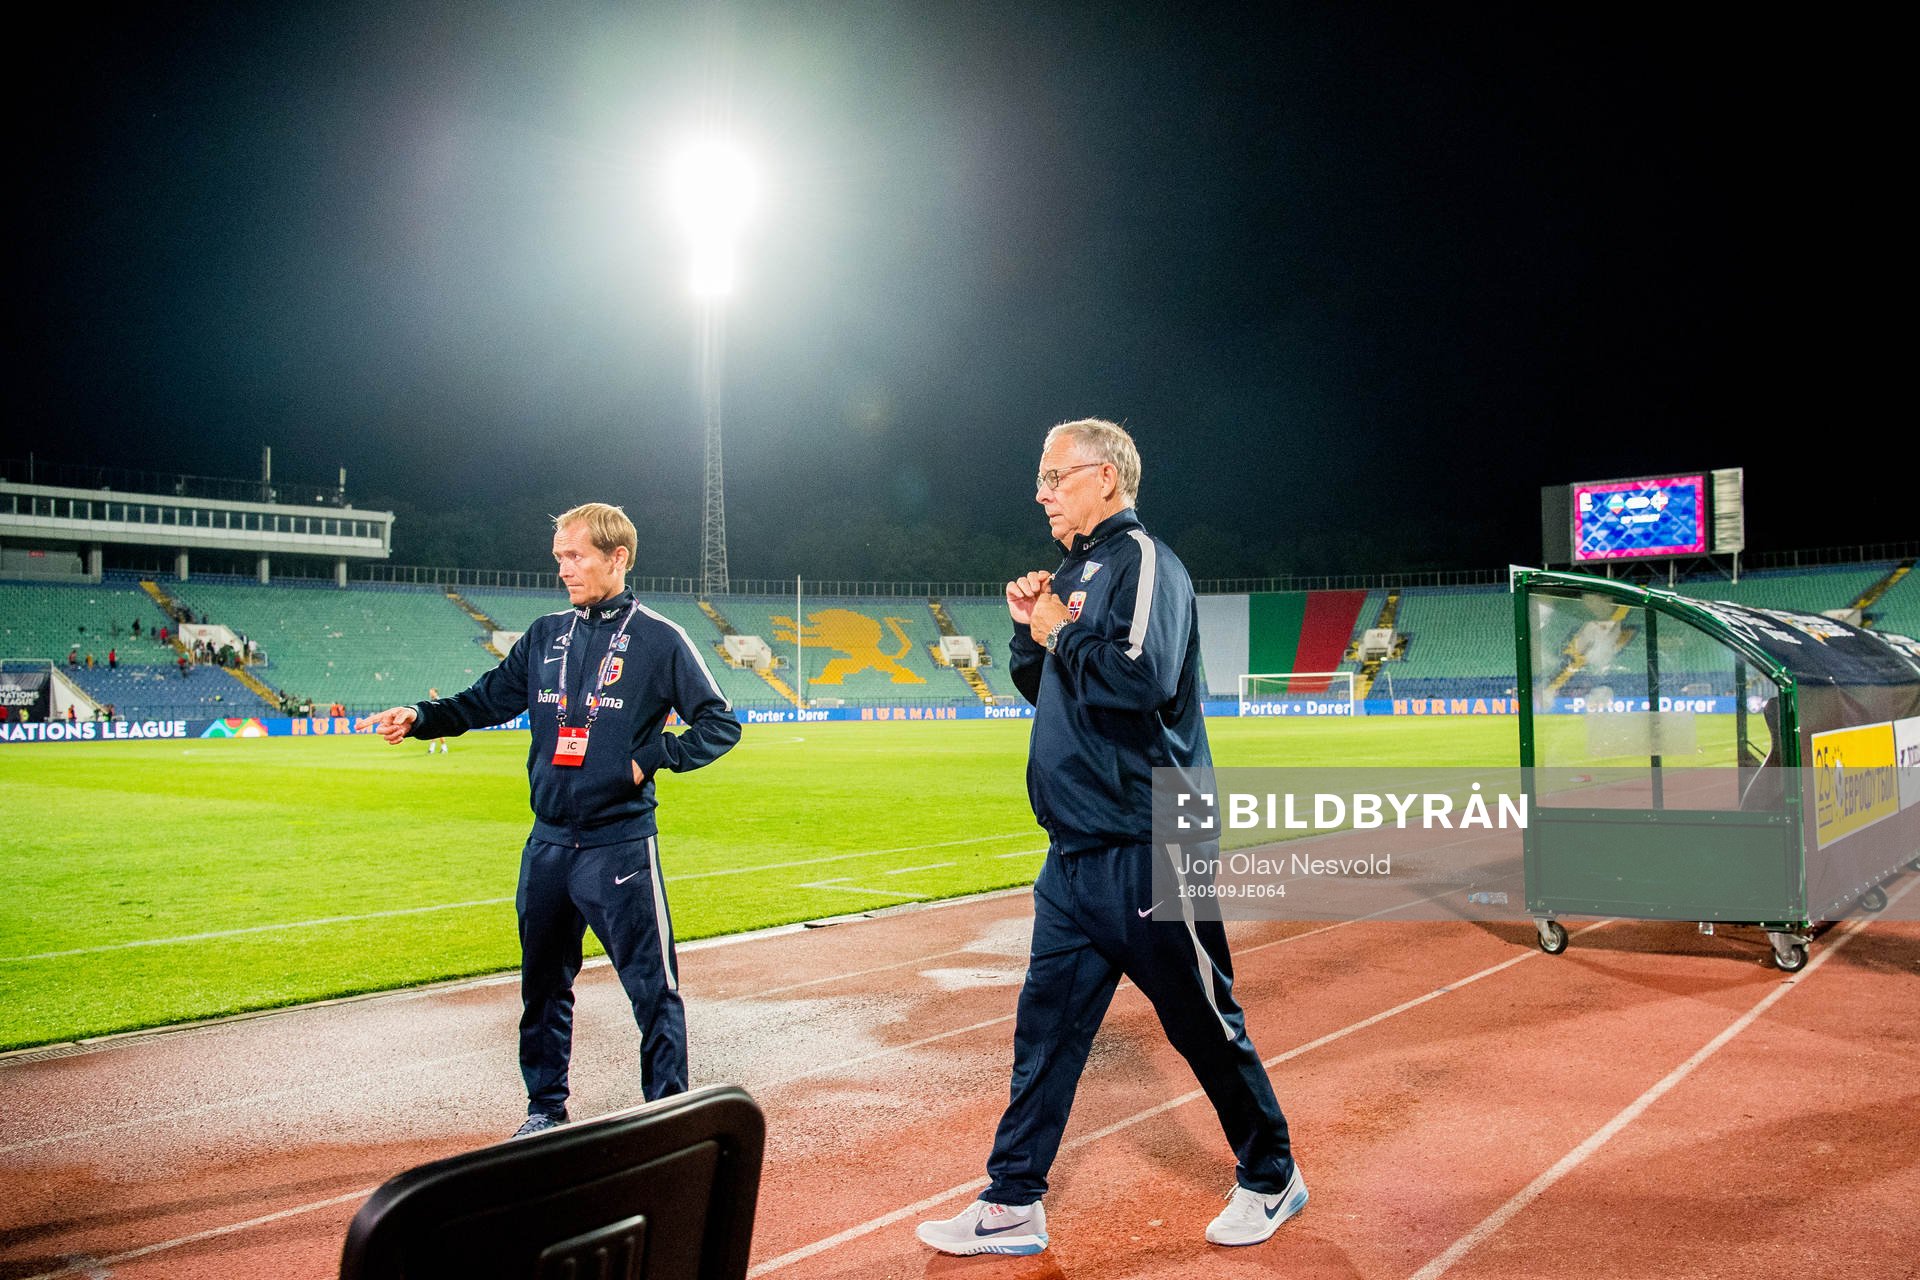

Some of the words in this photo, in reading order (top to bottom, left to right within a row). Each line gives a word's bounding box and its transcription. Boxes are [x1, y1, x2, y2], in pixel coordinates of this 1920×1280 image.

[0, 691, 39, 699] NATIONS
[0, 698, 34, 706] LEAGUE
[538, 689, 559, 704] bam
[586, 692, 624, 709] bma
[861, 707, 957, 720] HÖRMANN
[985, 705, 1021, 718] Porter
[1242, 701, 1287, 715] Porter
[748, 709, 784, 723] Porter
[0, 722, 96, 741] NATIONS
[103, 720, 187, 739] LEAGUE
[1815, 746, 1831, 802] 25
[1844, 763, 1894, 817] ЕВРОФУТБОЛ
